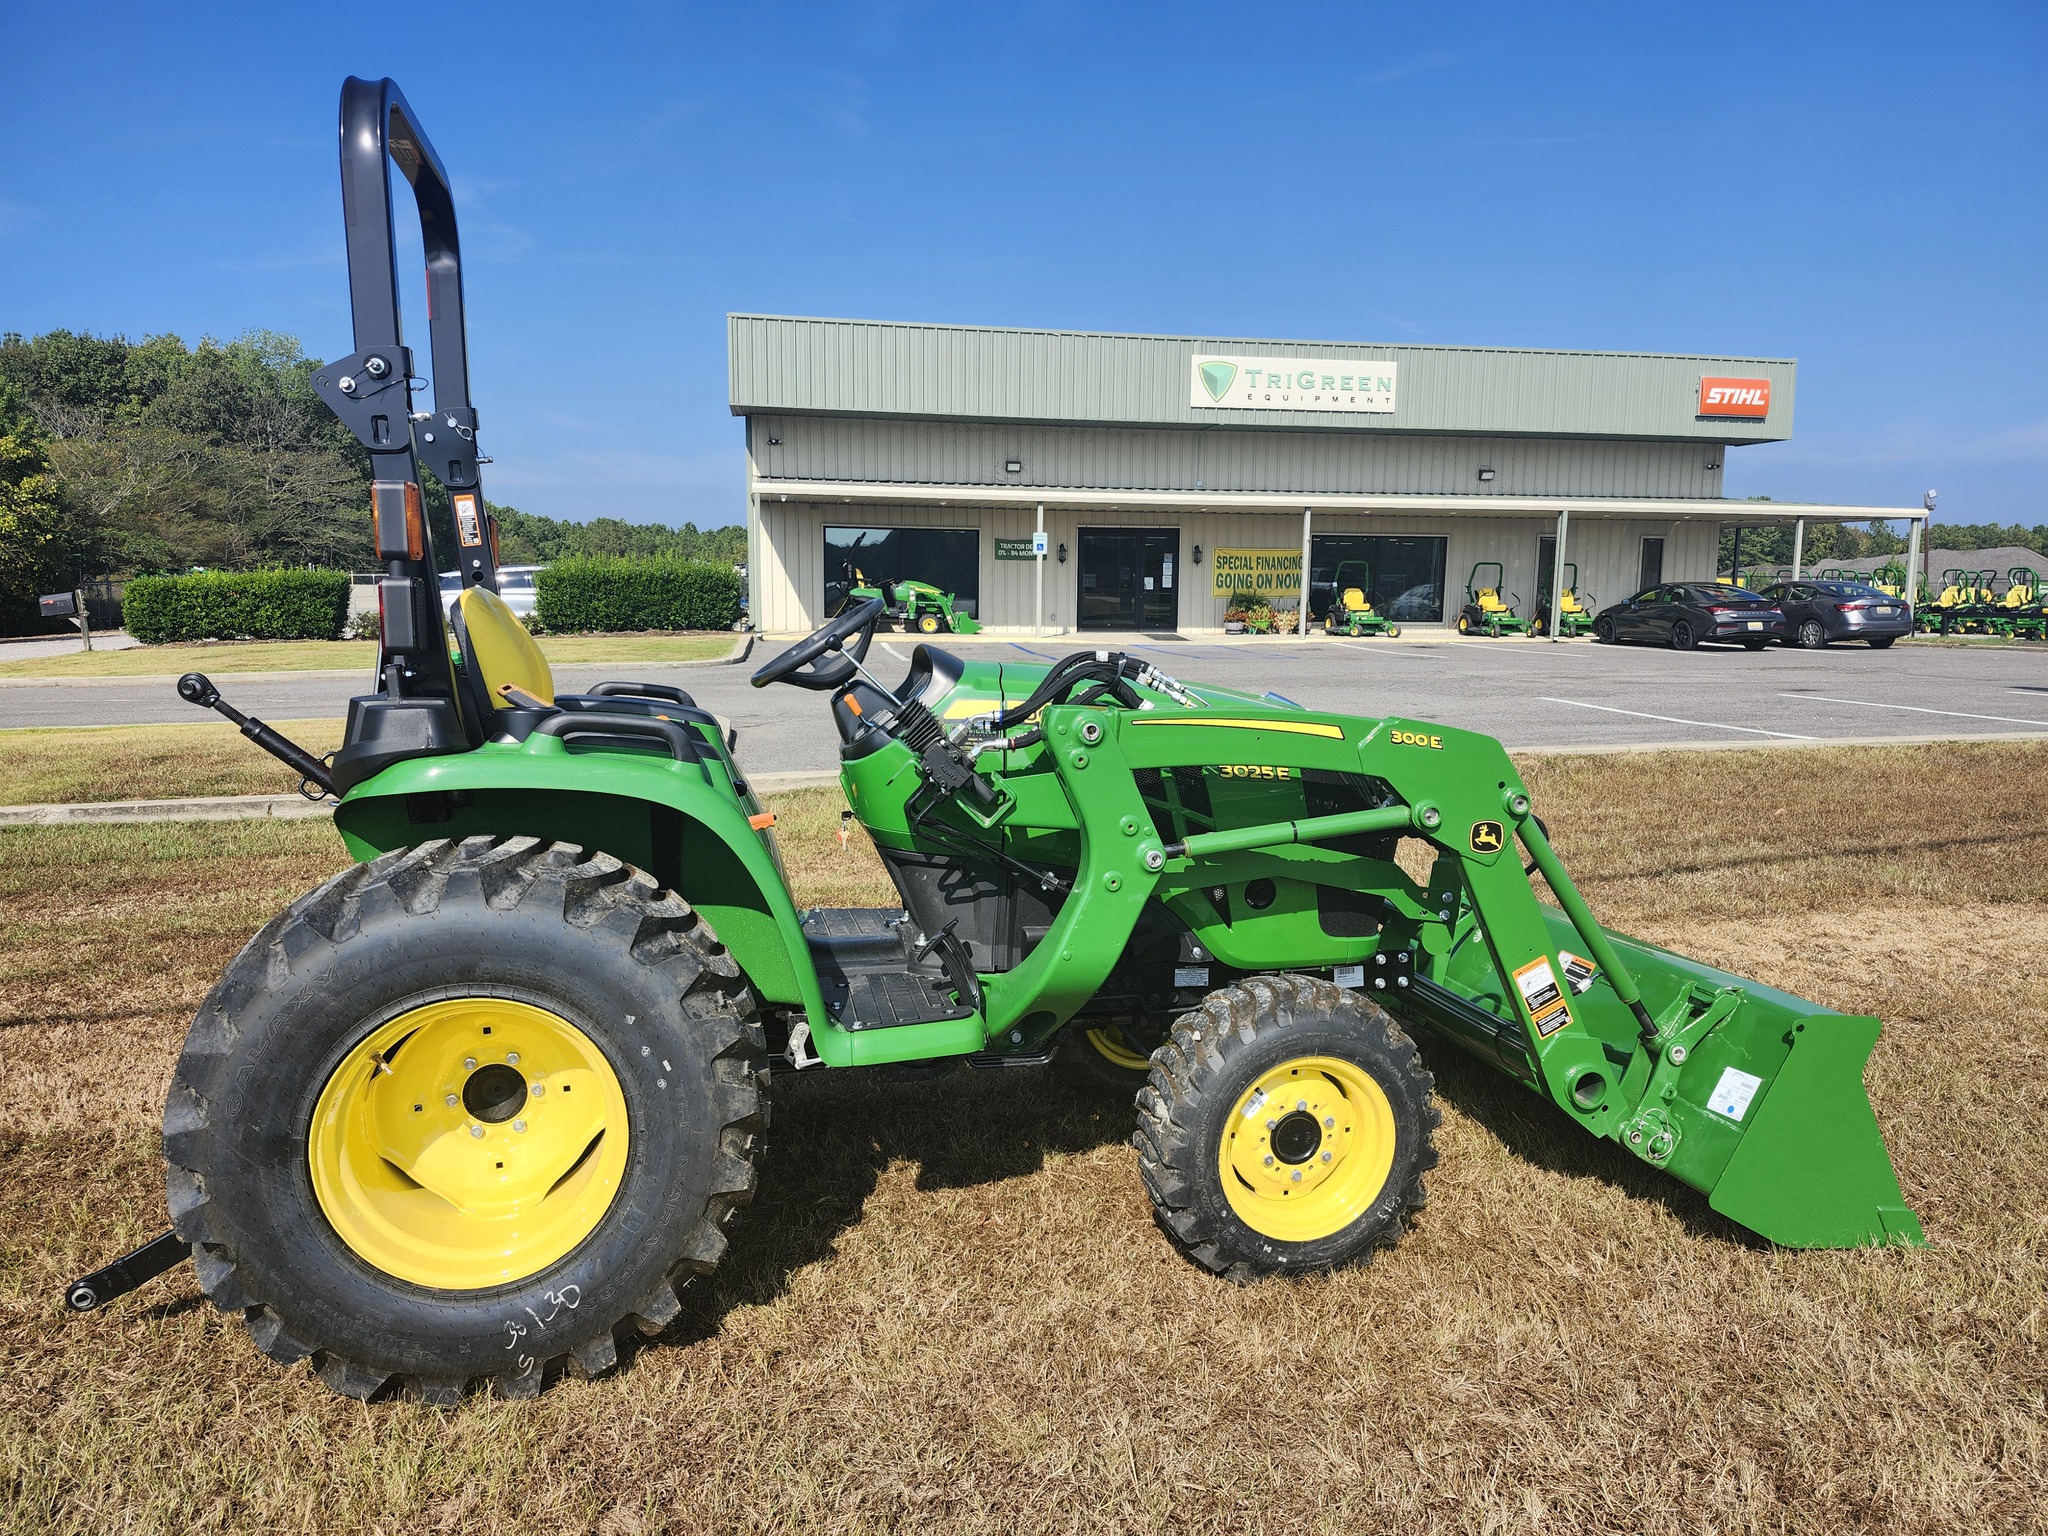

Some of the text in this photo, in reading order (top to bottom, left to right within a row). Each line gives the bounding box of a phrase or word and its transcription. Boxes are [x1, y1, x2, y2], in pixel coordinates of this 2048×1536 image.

[1247, 393, 1391, 404] EQUIPMENT
[1706, 387, 1766, 406] STIHL
[1216, 555, 1303, 571] SPECIAL FINANCING
[1216, 572, 1302, 590] GOING ON NOW
[1218, 764, 1291, 781] 3025E
[226, 964, 340, 1119] GALAXY
